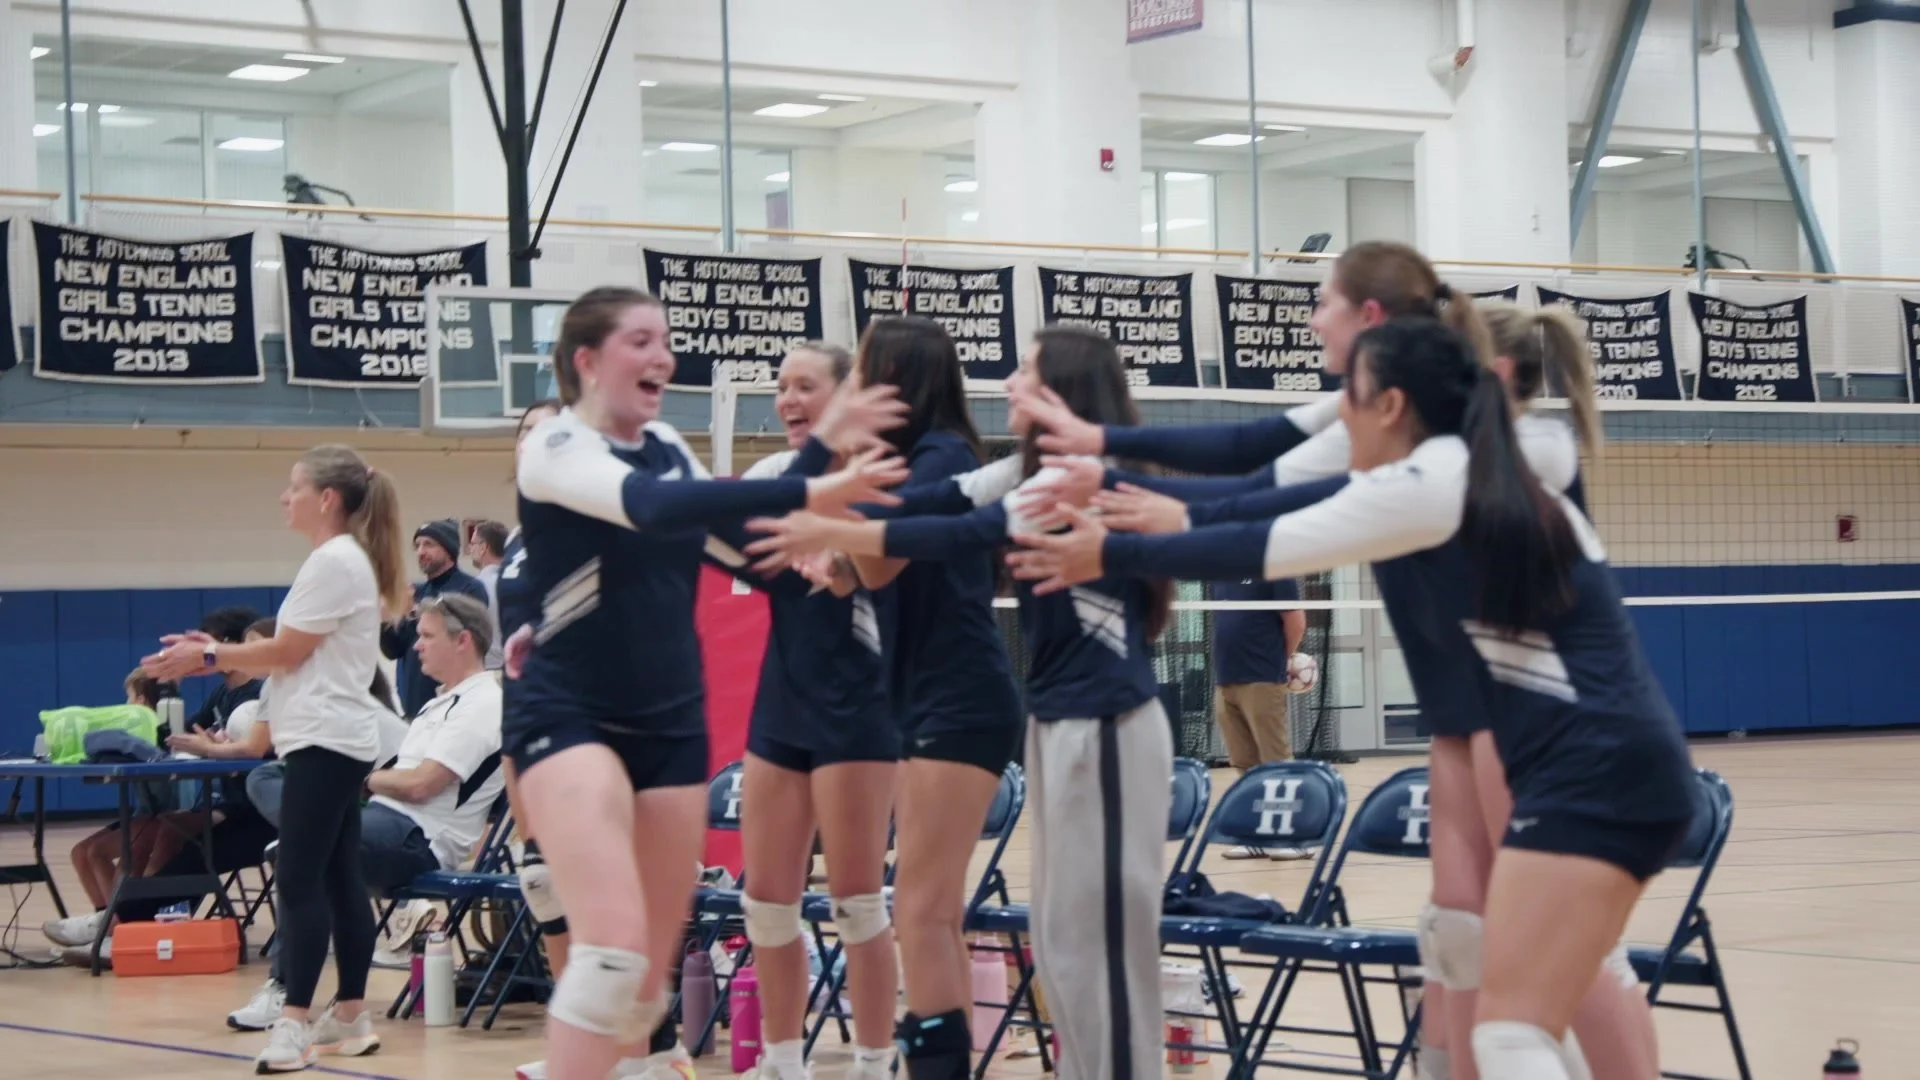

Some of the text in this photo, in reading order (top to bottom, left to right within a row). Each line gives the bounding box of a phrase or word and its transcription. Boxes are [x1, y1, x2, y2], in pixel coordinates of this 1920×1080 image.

[59, 233, 231, 262] THE HOTCHKISS SCHOOL
[308, 246, 338, 266] THE
[416, 251, 464, 272] SCHOOL
[54, 258, 237, 288] NEW ENGLAND
[303, 267, 473, 296] NEW ENGLAND
[661, 258, 807, 283] THE HOTCHKISS SCHOOL
[865, 268, 891, 286] THE
[960, 273, 1001, 290] SCHOOL
[660, 281, 809, 307] NEW ENGLAND
[1054, 274, 1079, 292] THE
[1142, 280, 1180, 296] SCHOOL
[1230, 283, 1255, 299] THE
[58, 288, 236, 316] GIRLS TENNIS
[309, 296, 381, 321] GIRLS
[863, 289, 1003, 314] NEW ENGLAND
[1053, 294, 1182, 318] NEW ENGLAND
[1228, 303, 1271, 322] NEW
[1704, 300, 1722, 317] THE
[59, 317, 233, 344] CHAMPIONS
[668, 307, 805, 332] BOYS TENNIS
[1592, 318, 1661, 338] ENGLAND
[1701, 317, 1799, 340] NEW ENGLAND
[1115, 322, 1180, 342] TENNIS
[1234, 326, 1285, 345] BOYS
[113, 348, 189, 371] 2013
[1116, 344, 1182, 364] PIONS
[1235, 349, 1328, 368] CHAMPIO
[1604, 341, 1659, 359] TENNIS
[1707, 340, 1799, 360] BOYS TENNIS
[1707, 361, 1799, 380] CHAMPIONS
[1735, 384, 1777, 401] 2012
[1255, 779, 1303, 835] H
